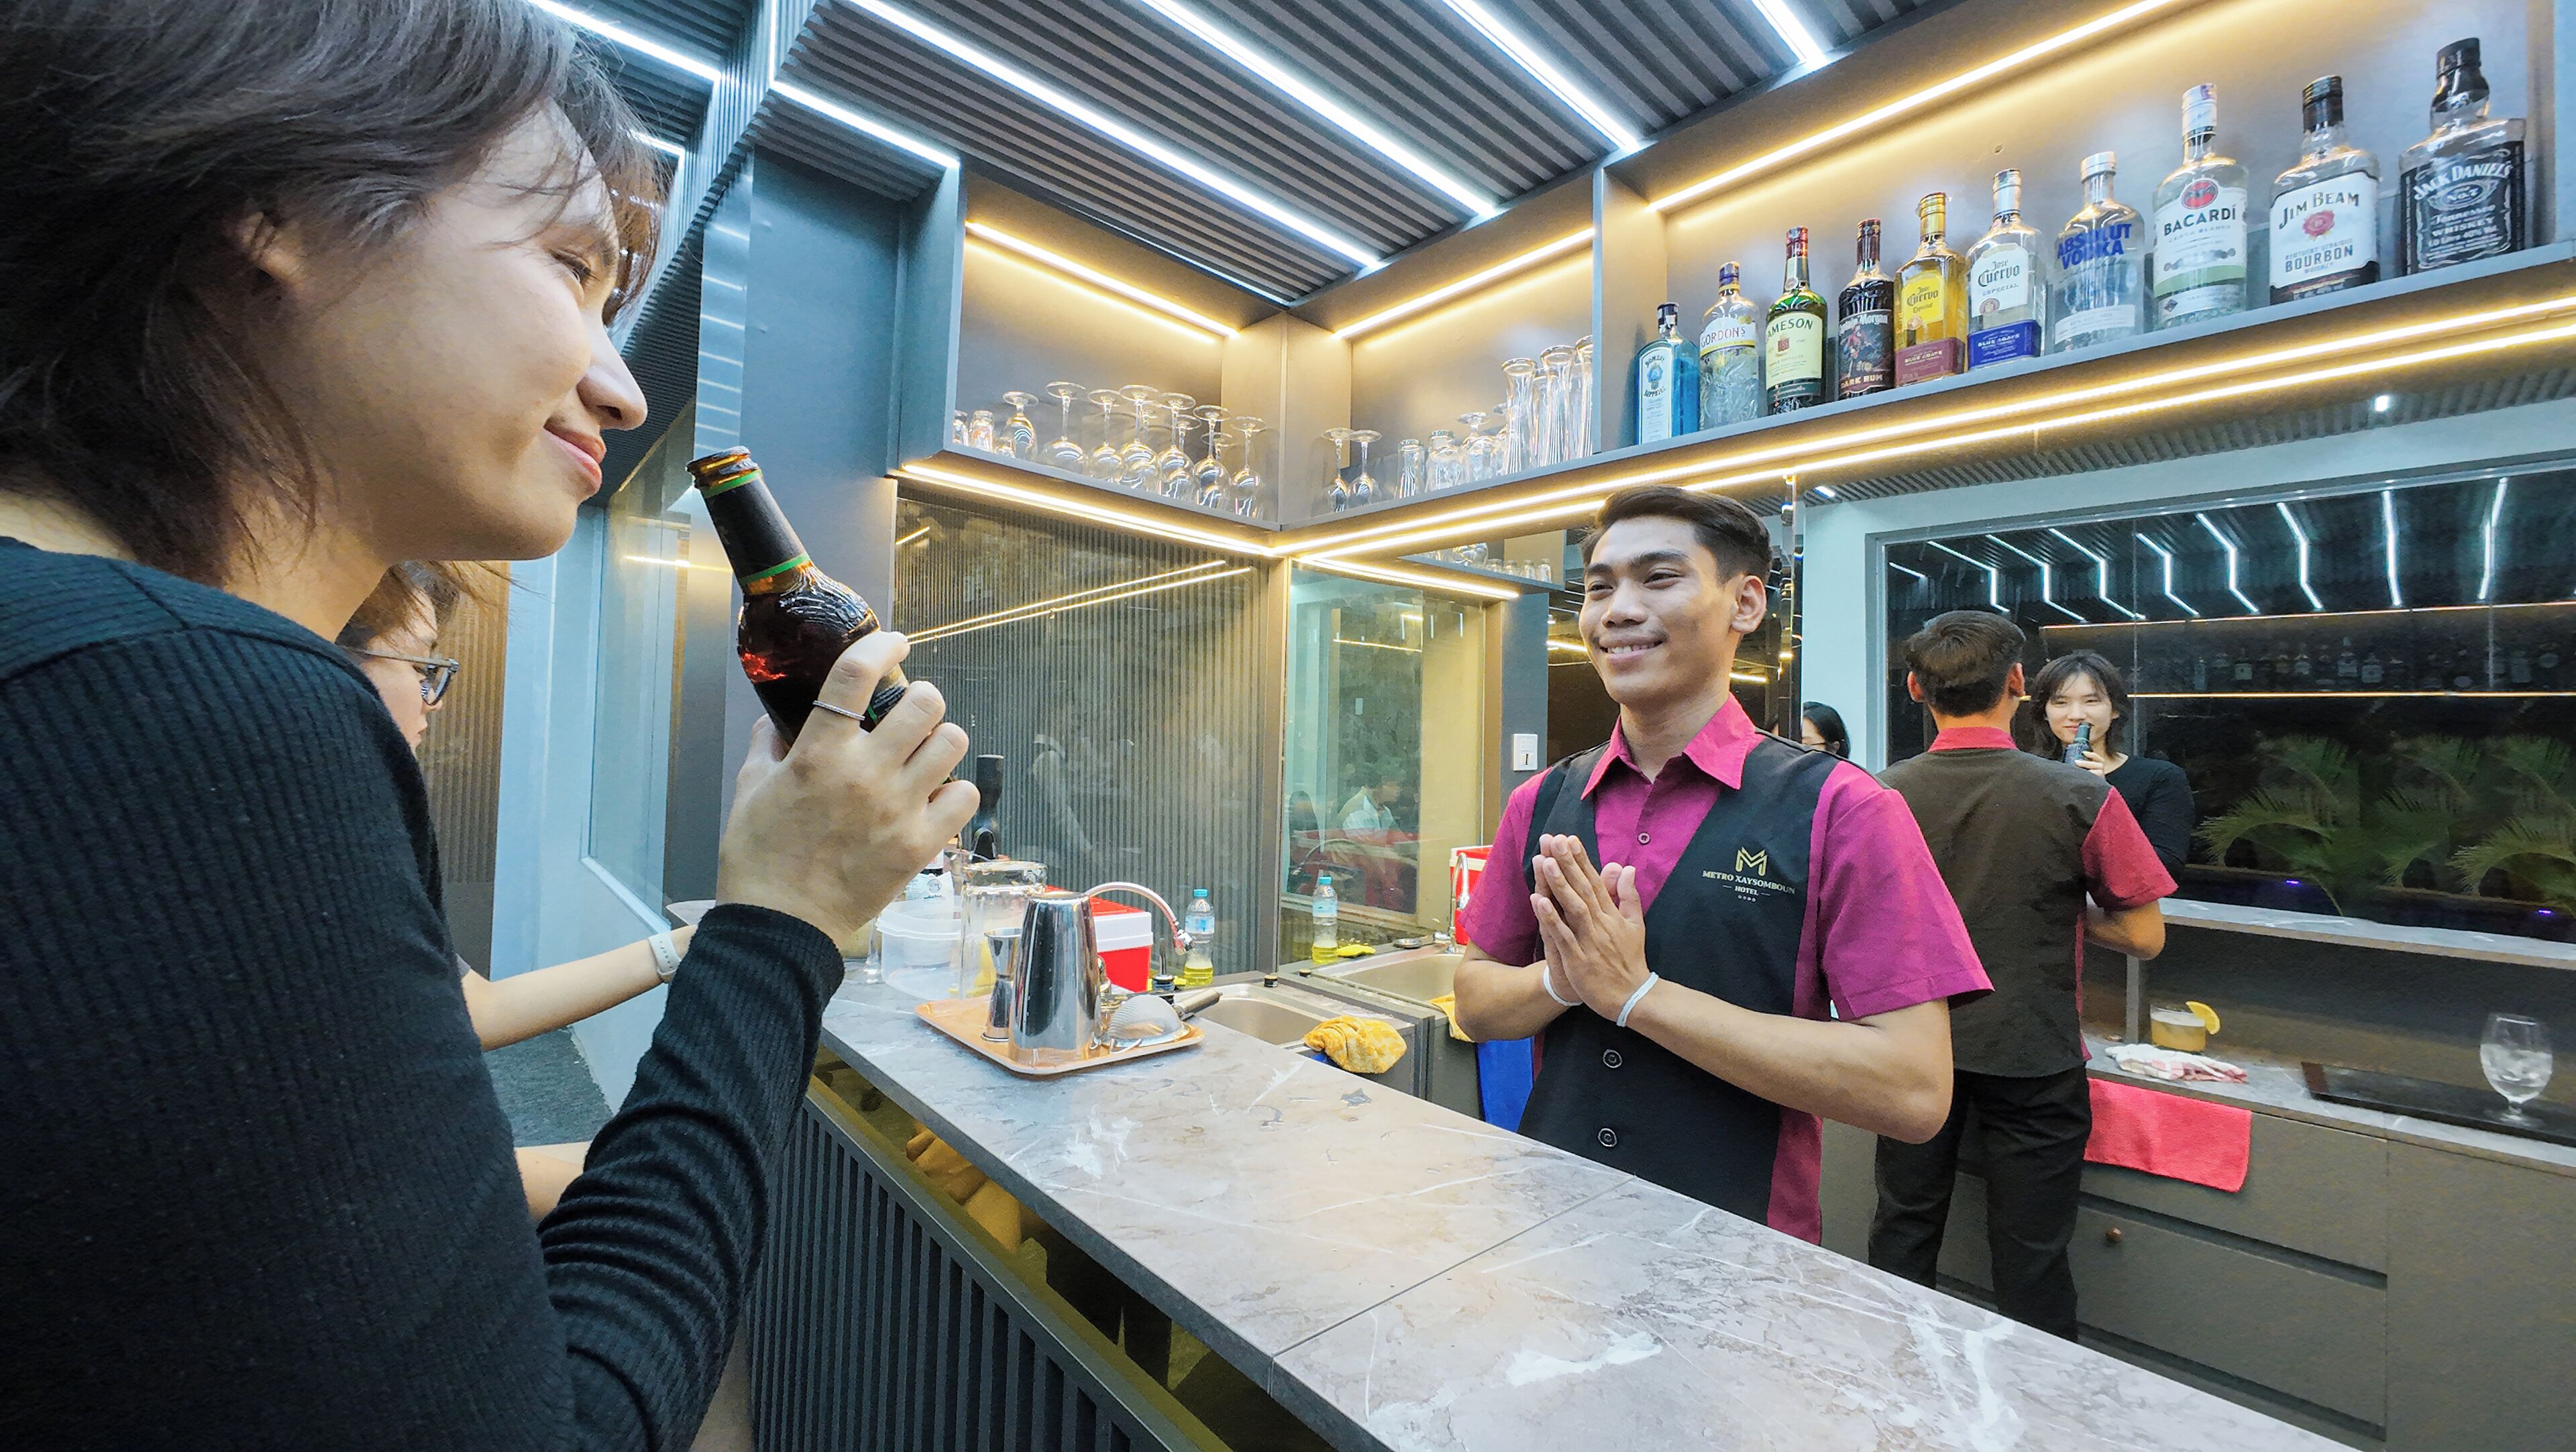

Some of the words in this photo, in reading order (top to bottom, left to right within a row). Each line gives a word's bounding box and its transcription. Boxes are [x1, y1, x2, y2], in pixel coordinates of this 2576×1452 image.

[2413, 174, 2451, 201] JACK
[2163, 204, 2237, 236] BACARDÍ
[2279, 201, 2308, 230] JIM
[2312, 192, 2360, 208] BEAM
[2285, 245, 2353, 272] BOURBON
[1978, 265, 2020, 287] Cuervo
[1907, 290, 1939, 306] Cuervo
[1766, 318, 1813, 341] AMESON
[1702, 871, 1735, 881] METRO
[1735, 875, 1796, 895] XAYSOMBOUN
[1734, 885, 1760, 896] HOTEL
